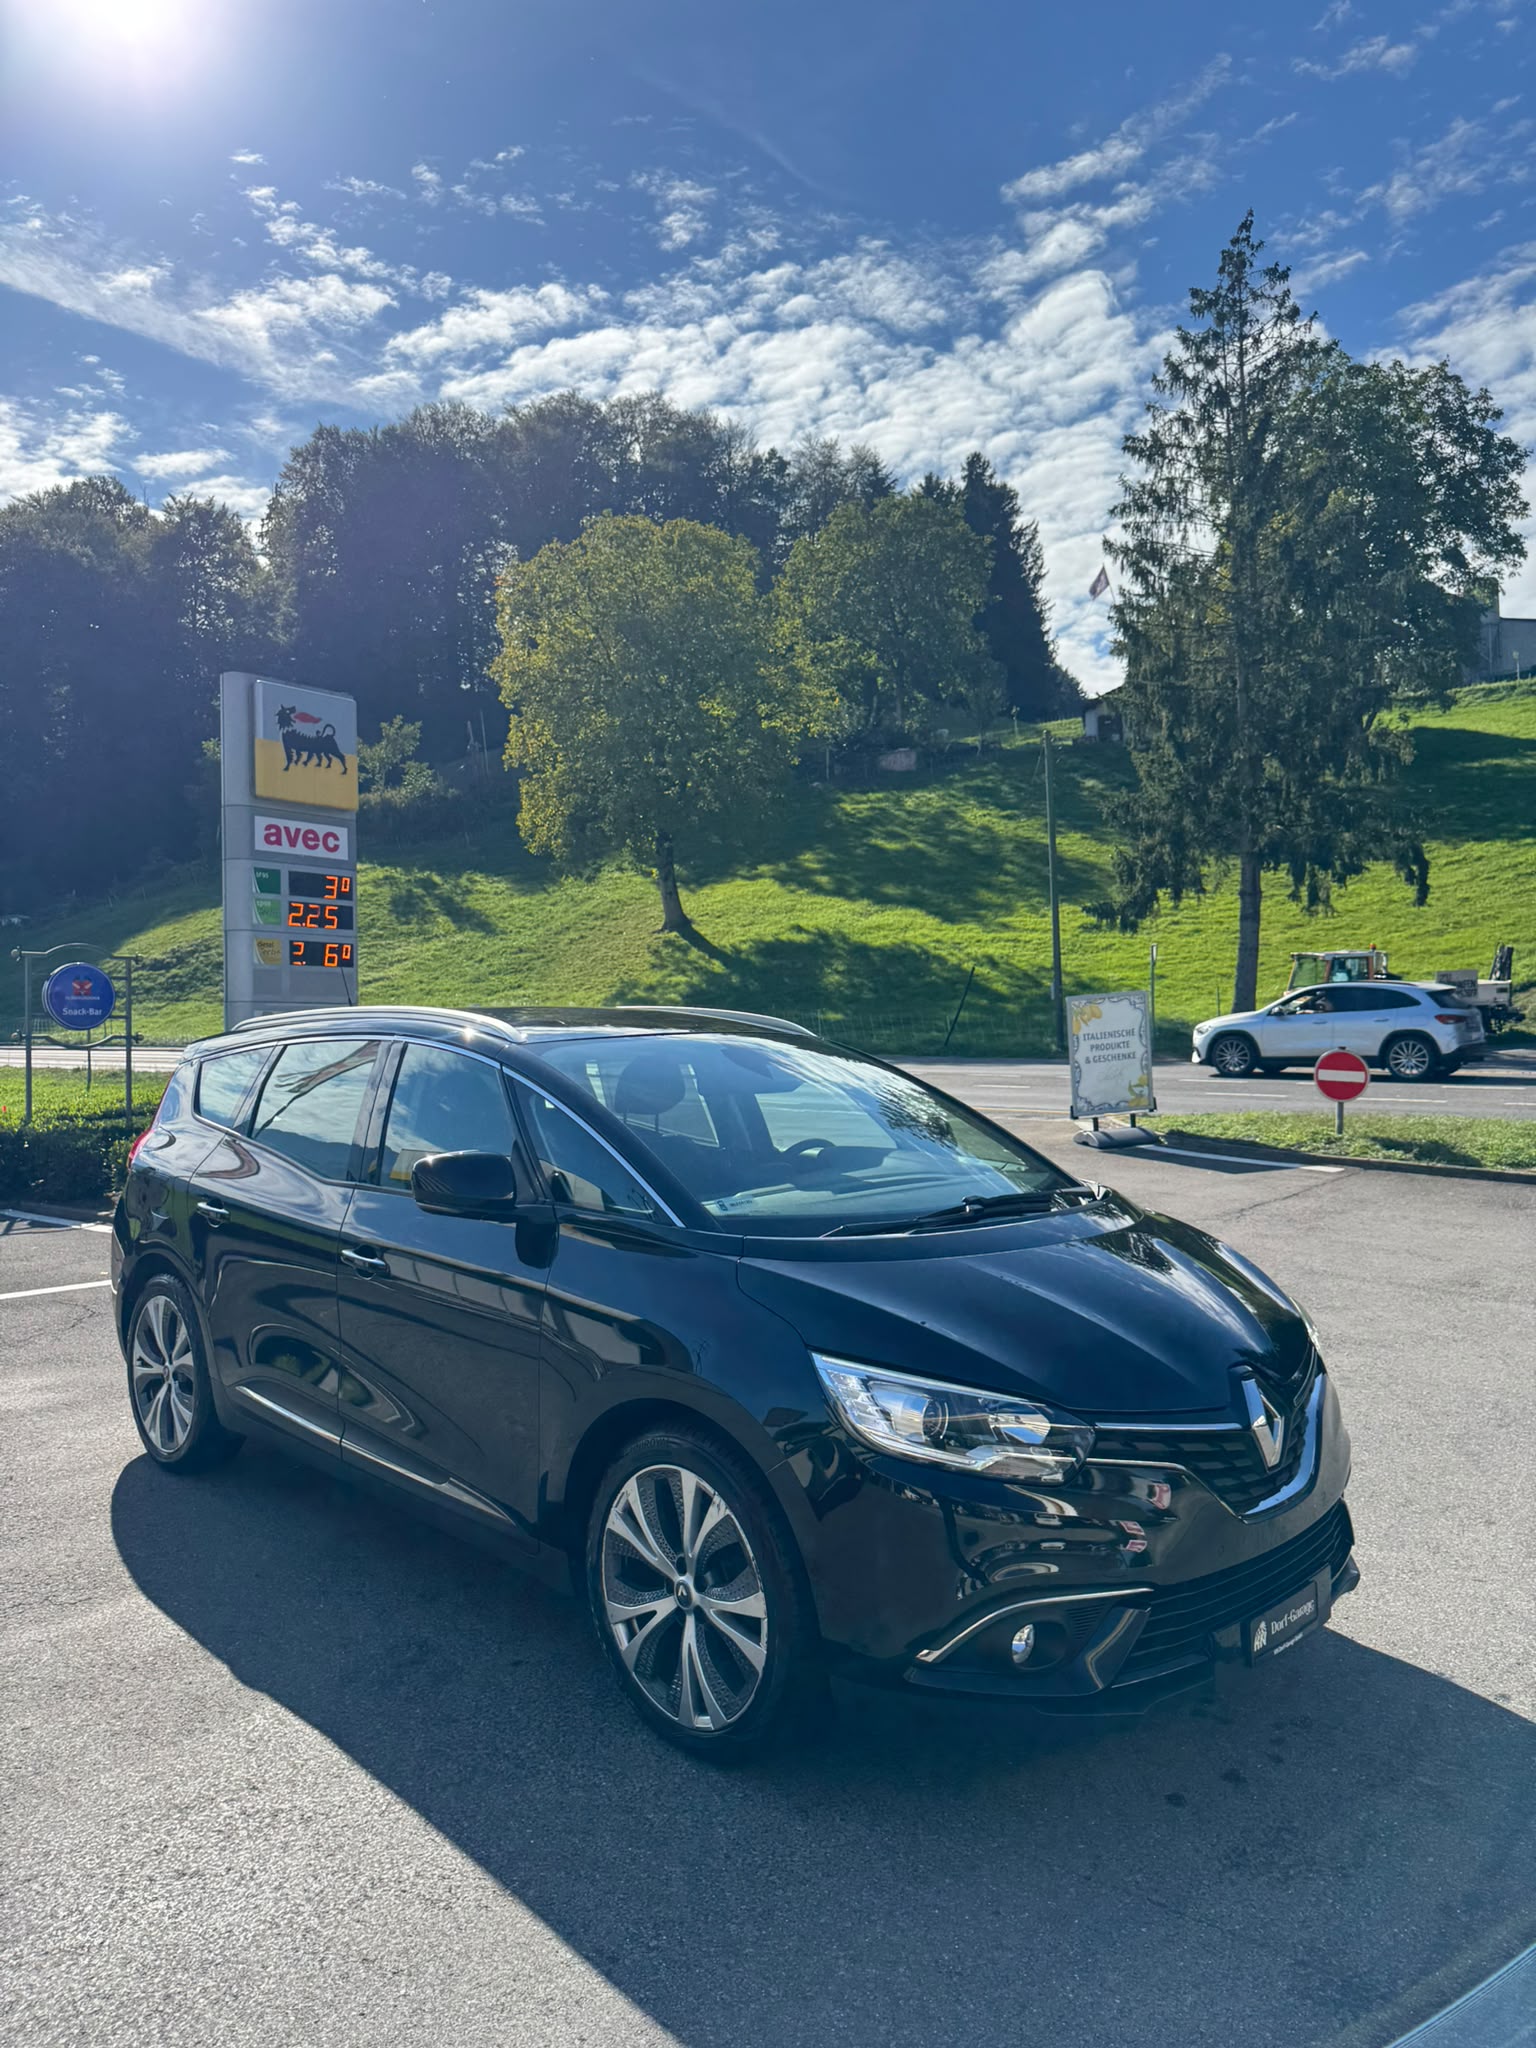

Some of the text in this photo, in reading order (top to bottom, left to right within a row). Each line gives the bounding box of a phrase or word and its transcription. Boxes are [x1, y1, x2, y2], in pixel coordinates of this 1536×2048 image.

[263, 823, 340, 853] avec
[288, 902, 338, 930] 2.25
[62, 1007, 102, 1016] Snack-Bar
[1083, 1028, 1136, 1041] ITALIENISCHE
[1090, 1040, 1131, 1052] PRODUKTE
[1085, 1052, 1137, 1064] & GESCHENKE
